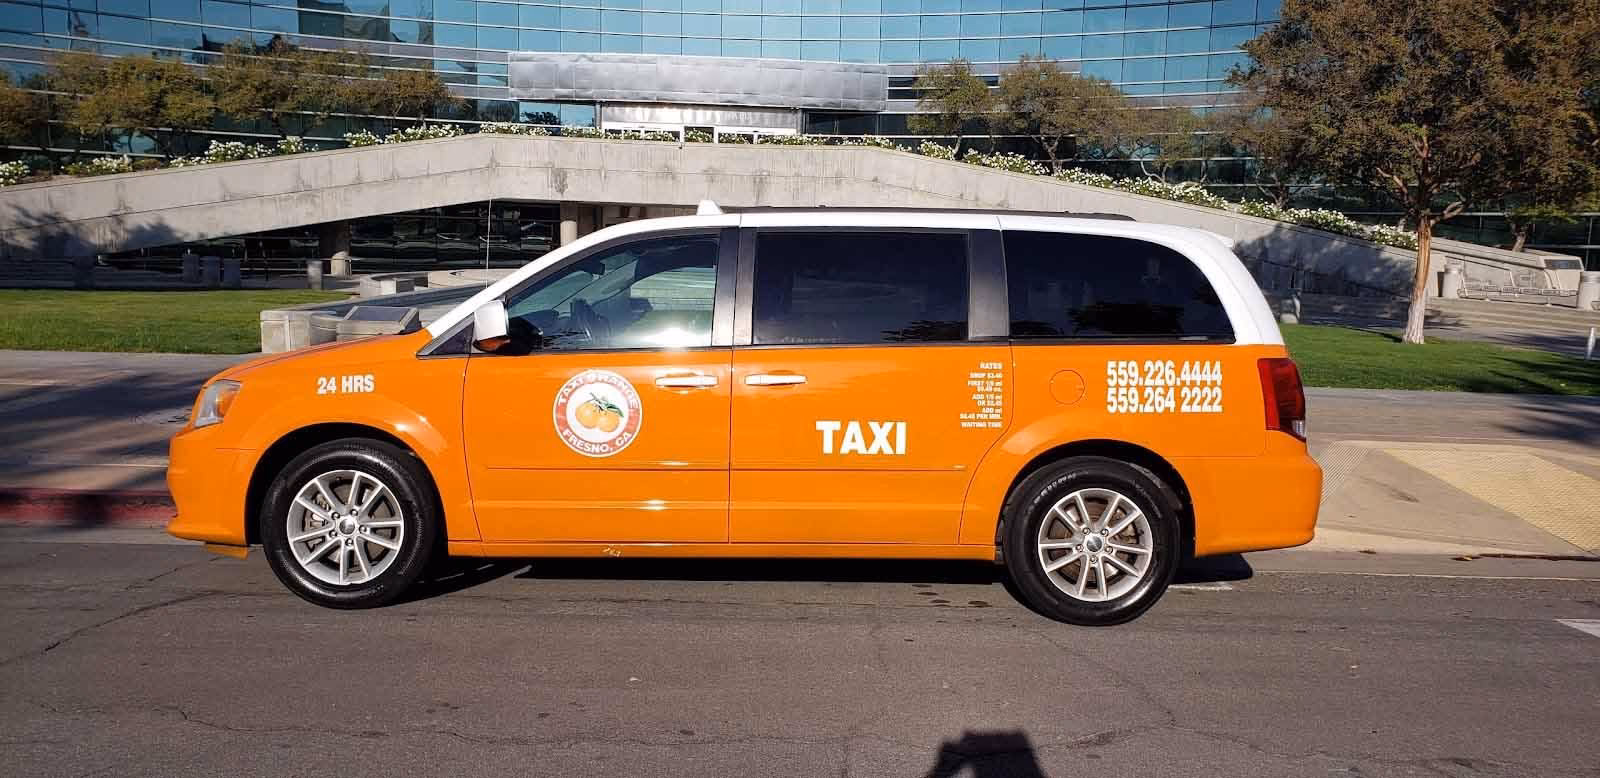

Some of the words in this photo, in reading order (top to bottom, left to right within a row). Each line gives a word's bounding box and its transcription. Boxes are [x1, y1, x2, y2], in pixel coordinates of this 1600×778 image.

[980, 361, 1002, 369] RATES
[1107, 360, 1222, 386] 559.226.4444
[317, 377, 336, 394] 24
[342, 375, 375, 393] HRS
[559, 377, 584, 405] TAXI
[1107, 386, 1176, 413] 559.264
[1181, 387, 1222, 413] 2222
[616, 431, 632, 447] CA
[816, 420, 906, 455] TAXI
